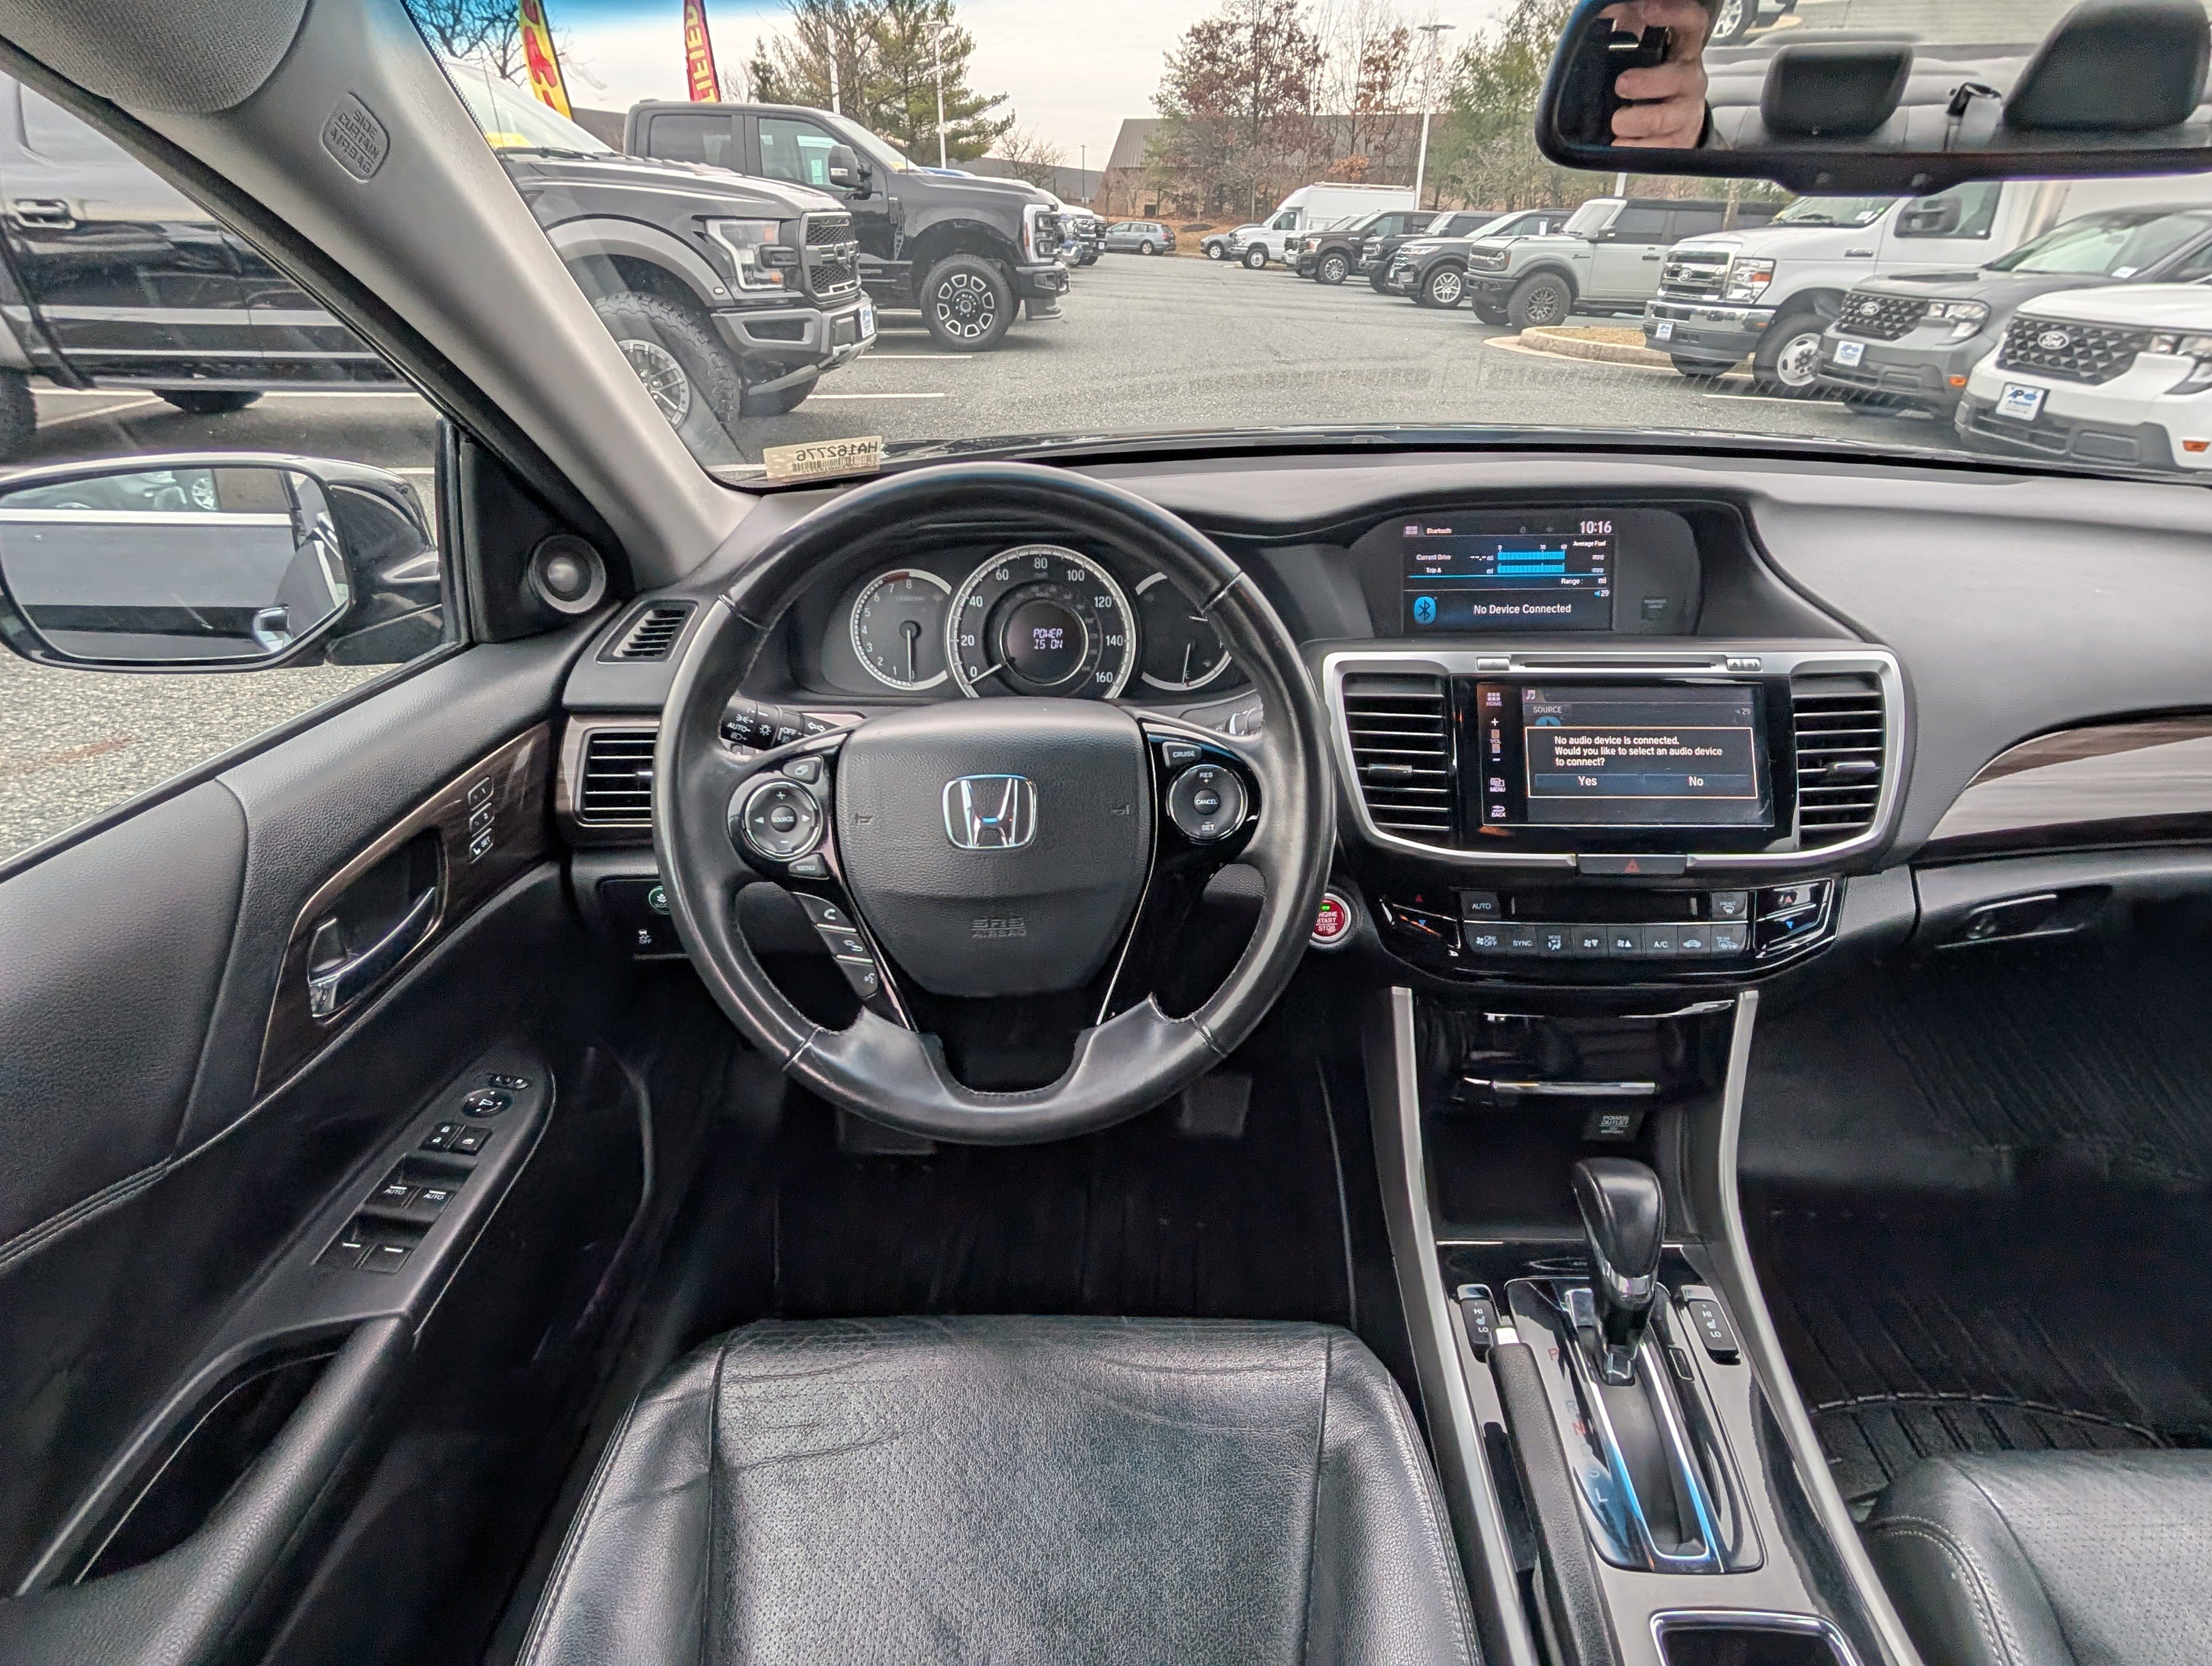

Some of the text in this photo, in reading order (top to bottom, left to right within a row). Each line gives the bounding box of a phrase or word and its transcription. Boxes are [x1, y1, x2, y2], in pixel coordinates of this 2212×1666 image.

[353, 109, 377, 140] SIDE
[339, 112, 380, 159] CURTAIN
[330, 128, 372, 174] AIRBAG
[1580, 521, 1612, 534] 10:16
[1034, 557, 1048, 569] 80
[996, 568, 1009, 581] 60
[1067, 569, 1085, 581] 100
[890, 584, 895, 593] 7
[874, 593, 880, 601] 6
[969, 595, 983, 607] 40
[1094, 596, 1112, 608] 120
[865, 608, 870, 617] 5
[1474, 604, 1572, 614] No Device Connected
[861, 625, 867, 635] 4
[1033, 628, 1063, 639] POWER
[961, 635, 975, 646] 20
[1034, 639, 1063, 650] IS ON
[1105, 635, 1123, 646] 140
[867, 643, 873, 652] 3
[877, 656, 883, 666] 2
[893, 666, 897, 675] 1
[970, 667, 978, 677] 0
[1095, 671, 1113, 683] 160
[1554, 735, 1680, 745] No audio device is connected.
[1555, 746, 1581, 755] Would
[1600, 746, 1616, 755] like
[1618, 747, 1627, 755] to
[1629, 746, 1655, 755] select
[1669, 746, 1693, 756] audio
[1694, 746, 1722, 756] device
[1555, 758, 1605, 766] to connect?
[1578, 776, 1597, 786] Yes
[1689, 776, 1703, 786] No
[973, 918, 1024, 928] SRS
[1547, 1348, 1559, 1361] P
[1572, 1421, 1586, 1436] N
